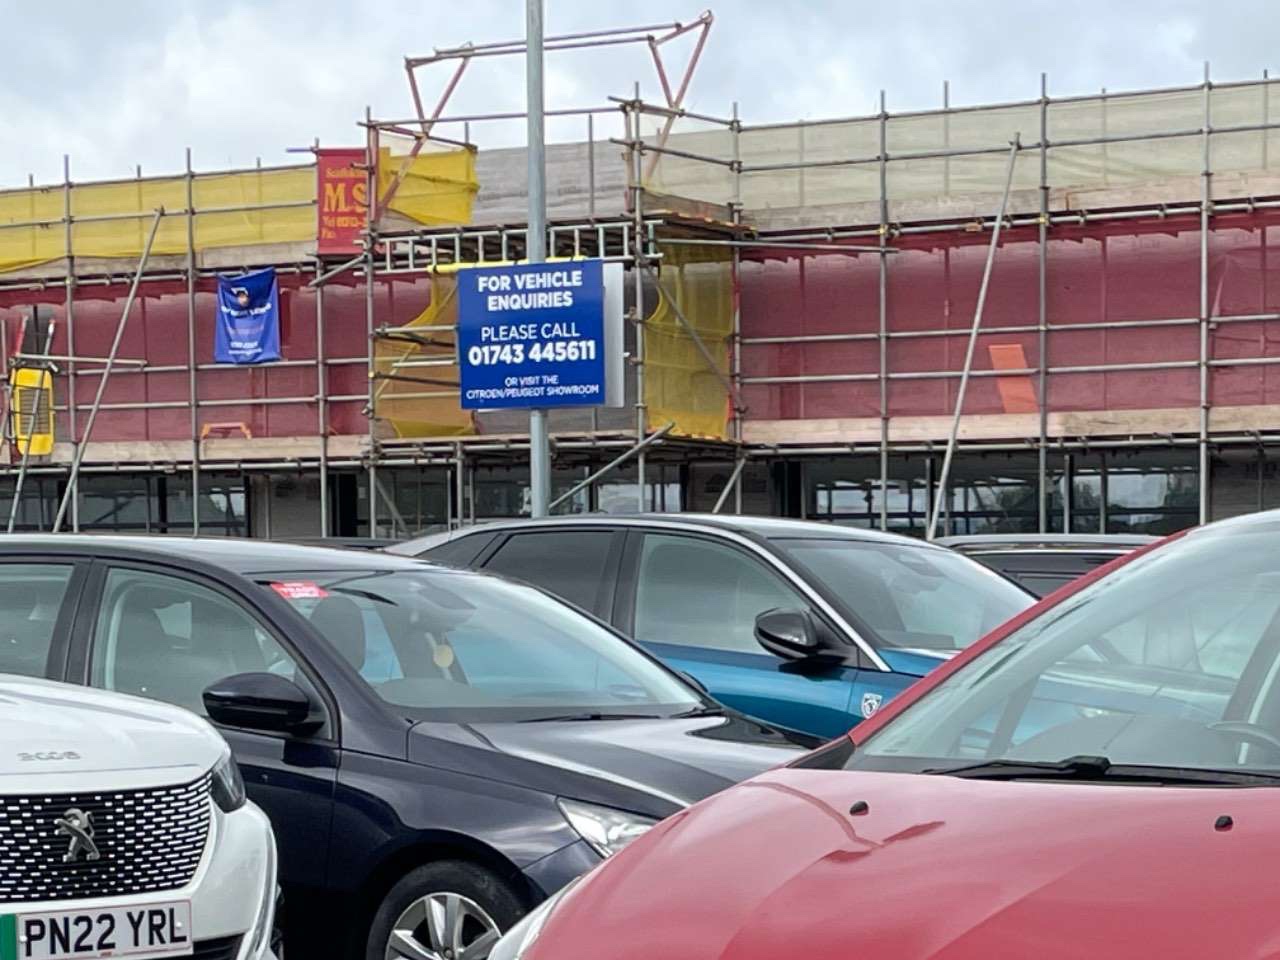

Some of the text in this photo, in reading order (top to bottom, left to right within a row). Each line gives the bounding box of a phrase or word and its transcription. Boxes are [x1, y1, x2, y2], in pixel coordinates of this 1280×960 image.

[478, 270, 583, 292] FOR VEHICLE
[487, 291, 573, 311] ENQUIRIES
[481, 322, 580, 341] PLEASE CALL
[468, 340, 596, 366] 01743 445611
[505, 375, 559, 386] OR VISIT THE
[546, 384, 599, 396] SHOWROOM
[24, 907, 187, 957] PN22 YRL
